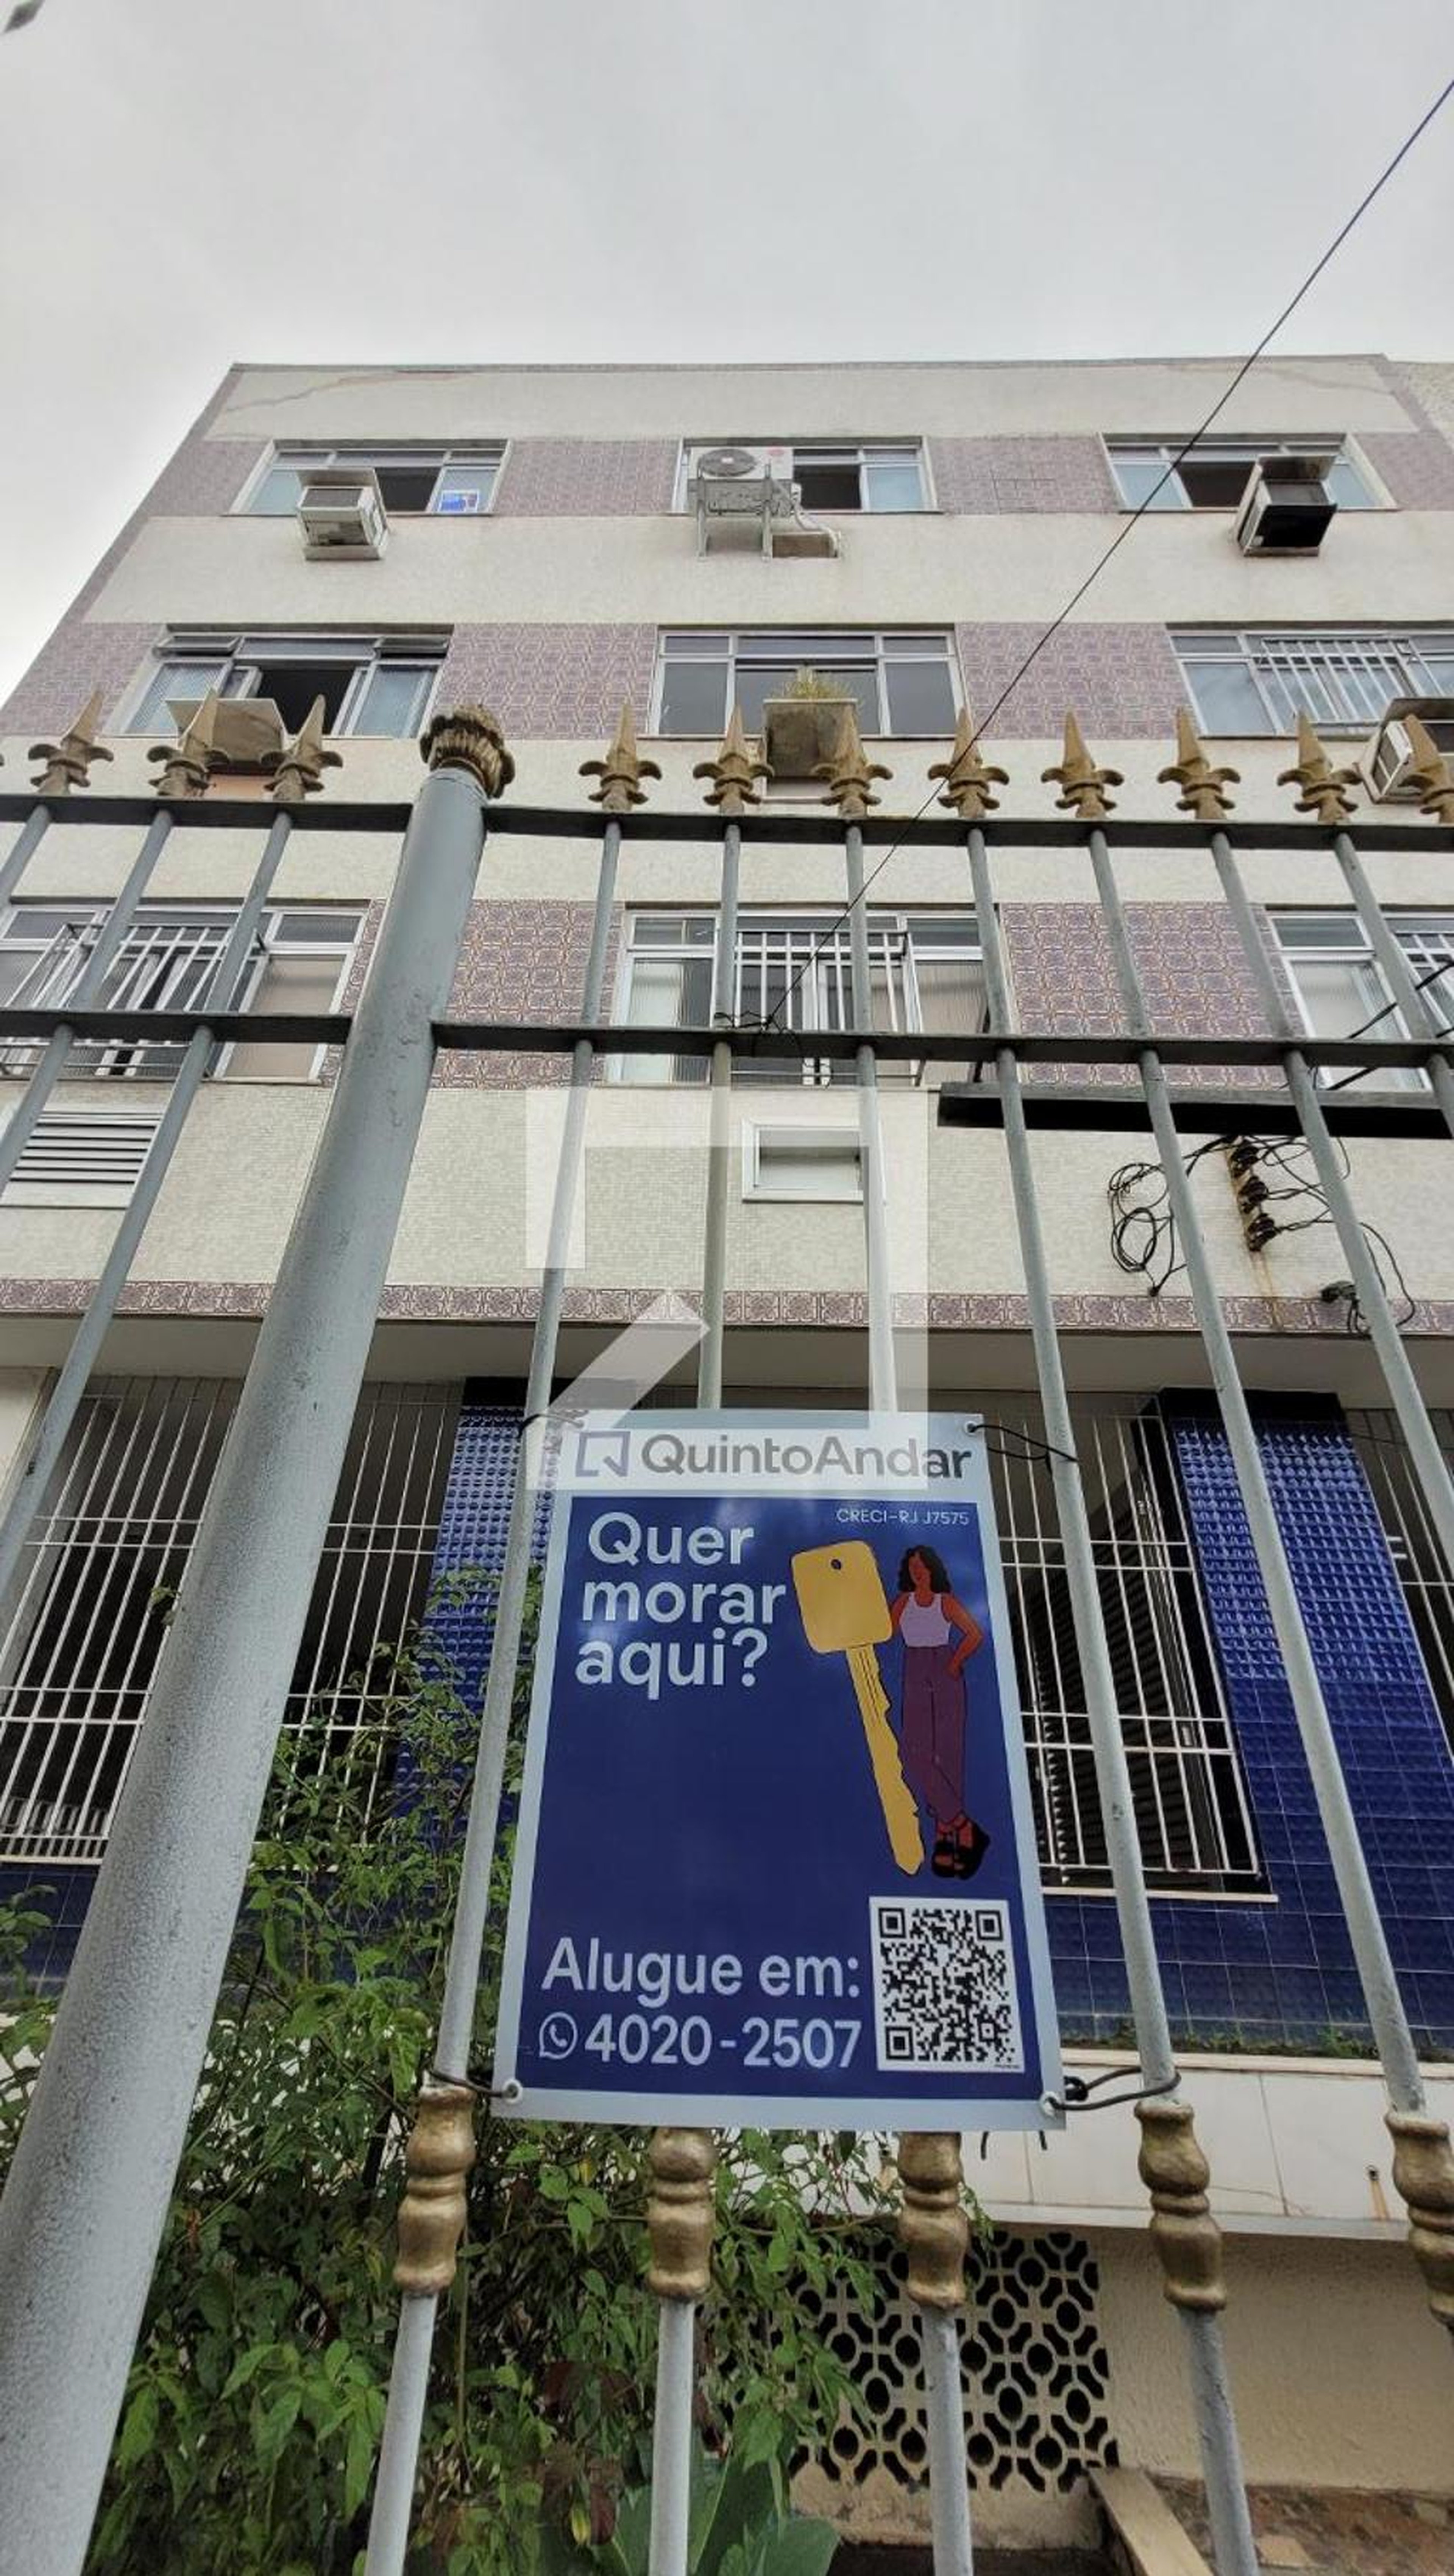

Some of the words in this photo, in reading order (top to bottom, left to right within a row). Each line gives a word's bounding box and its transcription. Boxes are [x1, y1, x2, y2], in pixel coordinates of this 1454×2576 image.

[641, 1433, 972, 1478] QuintoAndar
[588, 1512, 754, 1566] Quer
[836, 1508, 918, 1524] CRECI-RJ
[923, 1511, 970, 1525] J7575
[582, 1581, 786, 1624] morar
[575, 1627, 768, 1700] aqui?
[541, 1936, 743, 2008] Alugue
[759, 1954, 860, 1998] em:
[585, 2013, 862, 2068] 4020-2507
